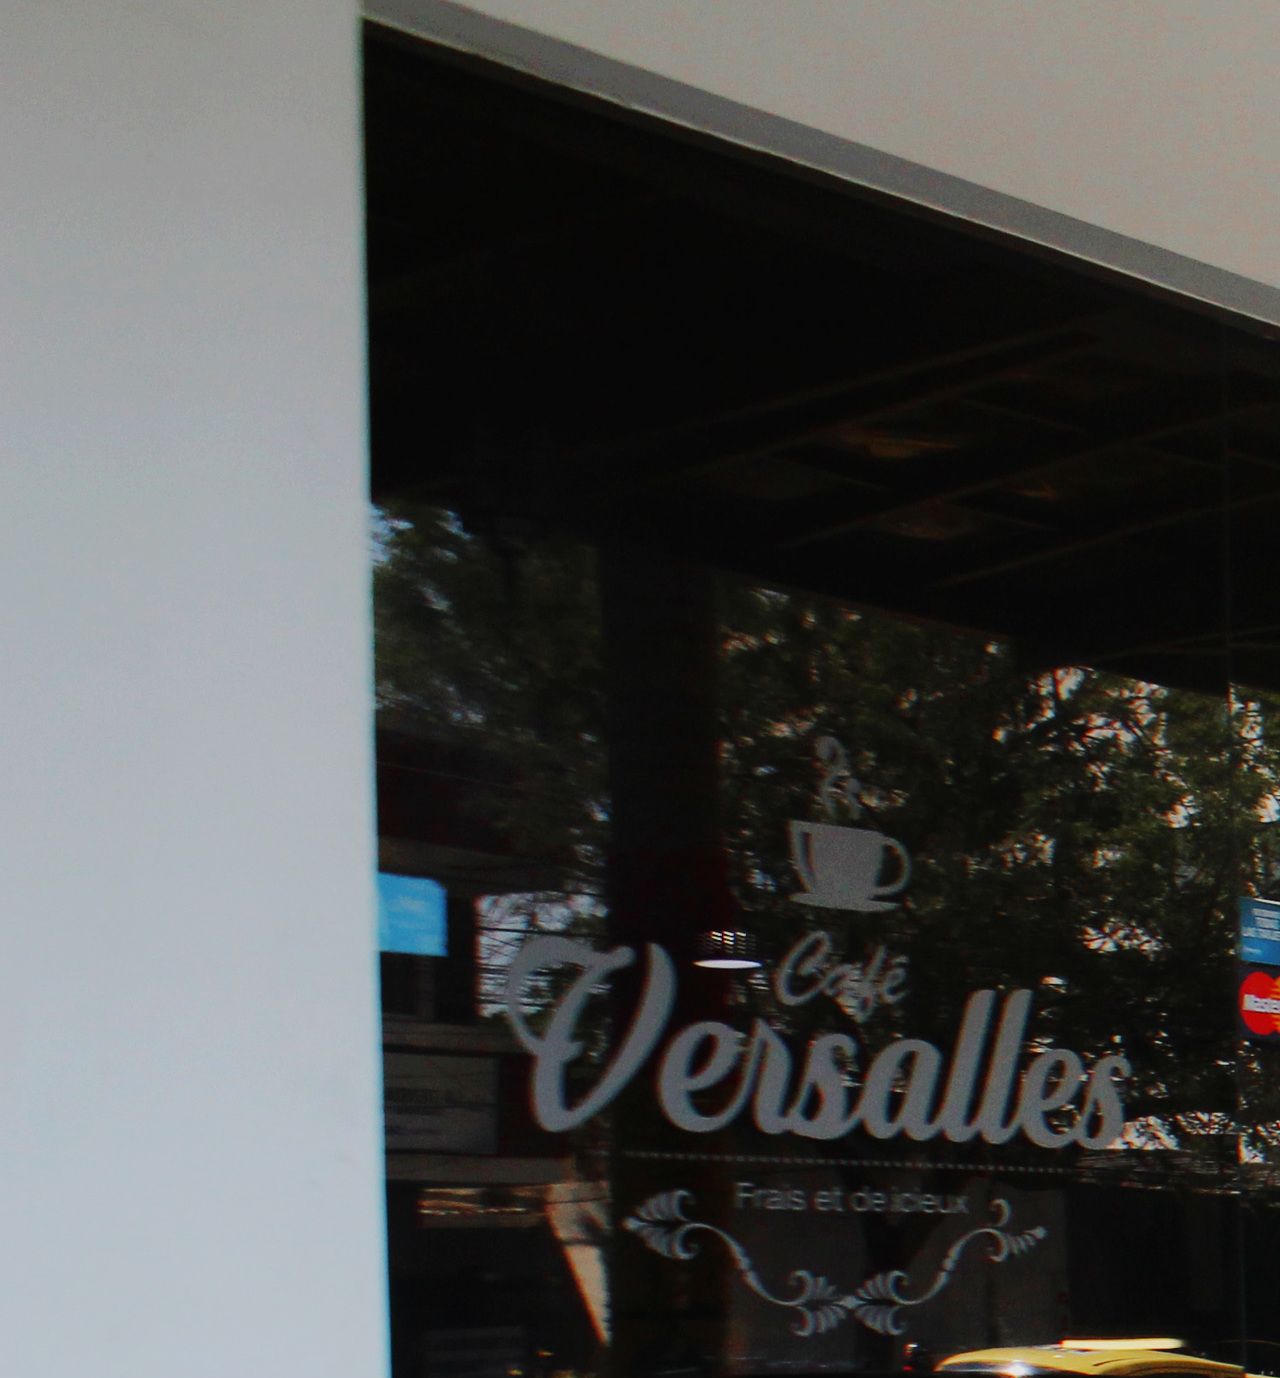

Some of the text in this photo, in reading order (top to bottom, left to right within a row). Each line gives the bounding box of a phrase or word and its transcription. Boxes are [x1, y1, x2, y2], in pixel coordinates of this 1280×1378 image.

[774, 929, 912, 1024] Café
[505, 936, 1133, 1151] Versalles
[735, 1181, 807, 1212] Frais
[813, 1185, 845, 1212] et
